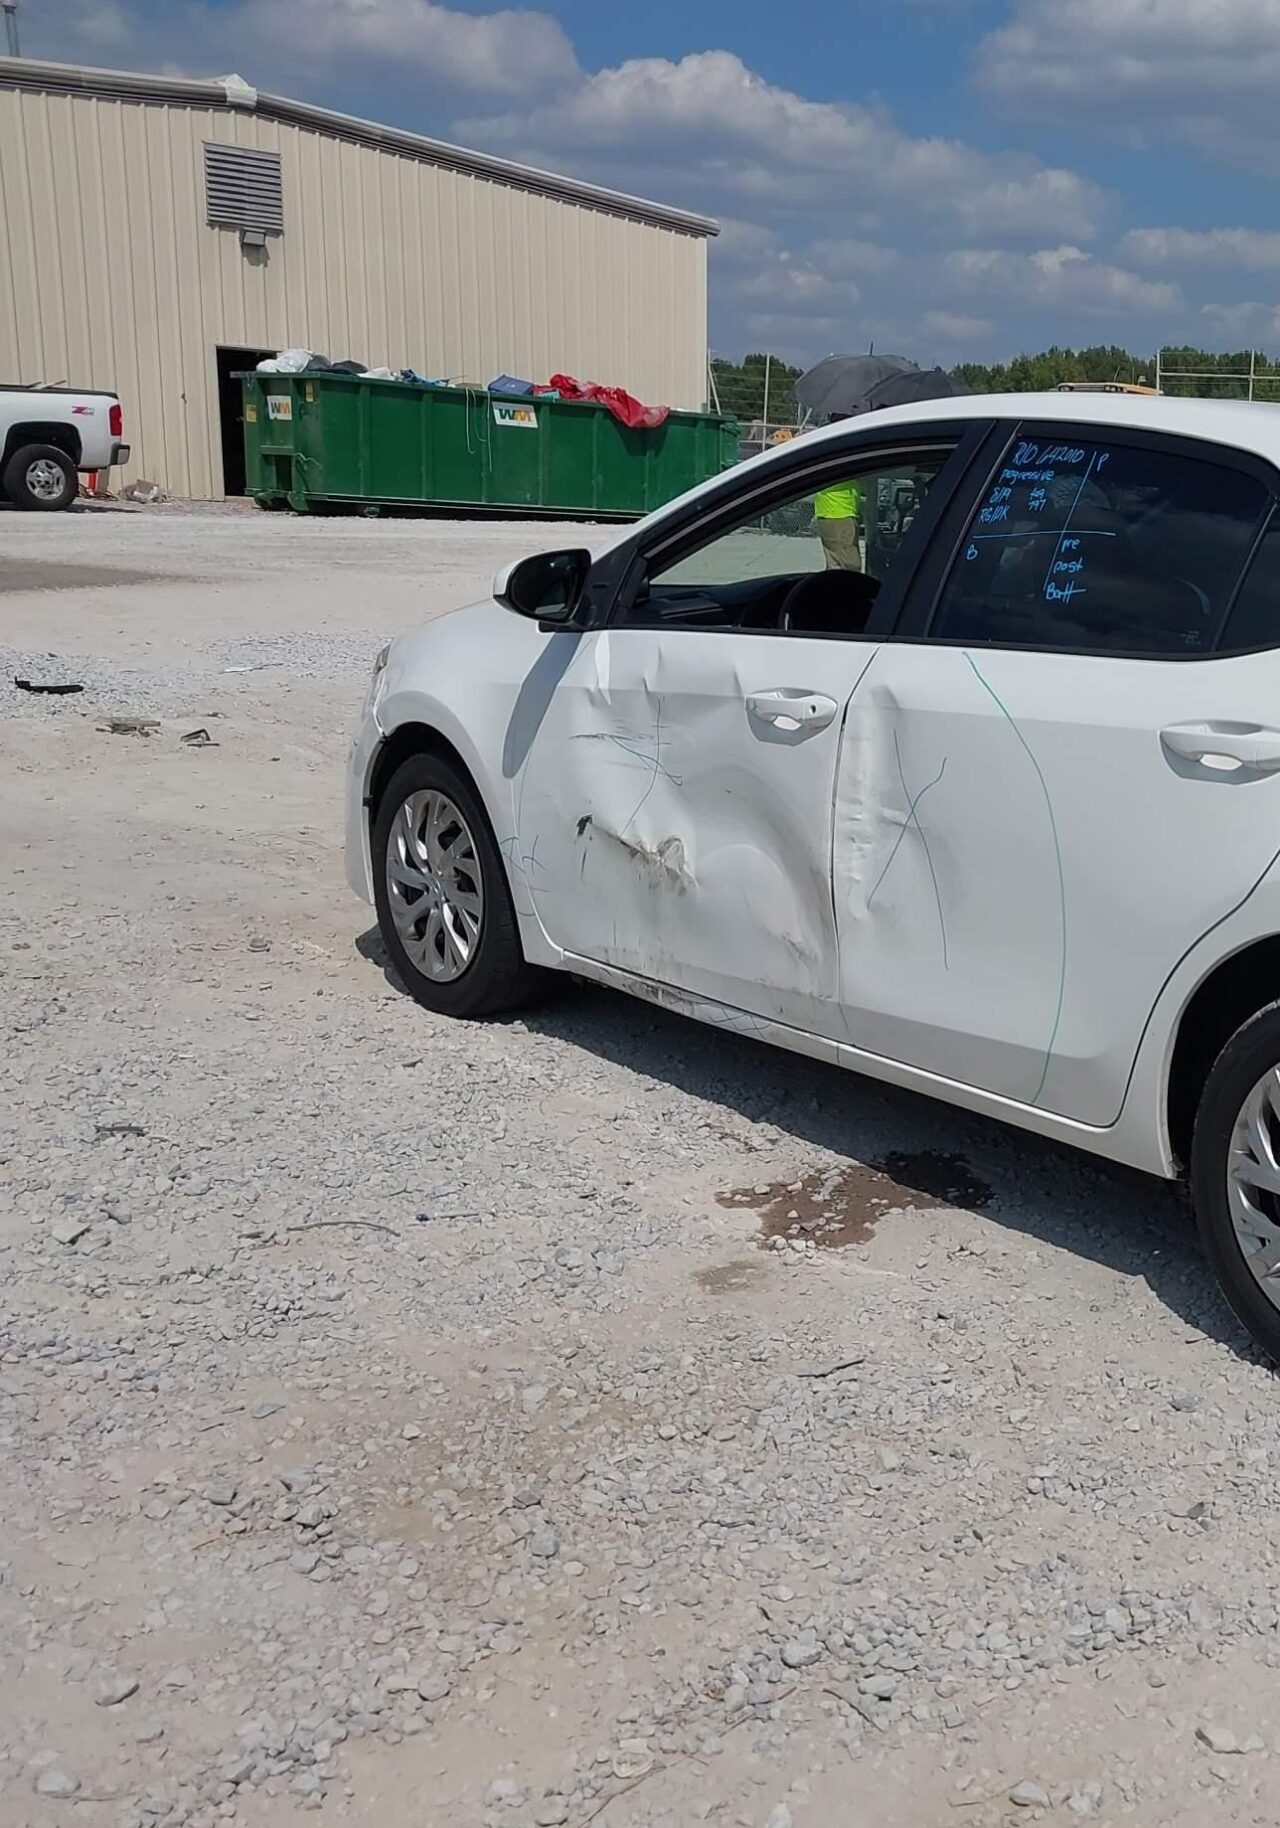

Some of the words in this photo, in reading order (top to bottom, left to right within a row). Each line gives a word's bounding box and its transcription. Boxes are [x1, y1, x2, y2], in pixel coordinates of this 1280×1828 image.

[271, 402, 290, 414] WM
[499, 408, 532, 422] WM
[1053, 557, 1083, 574] post
